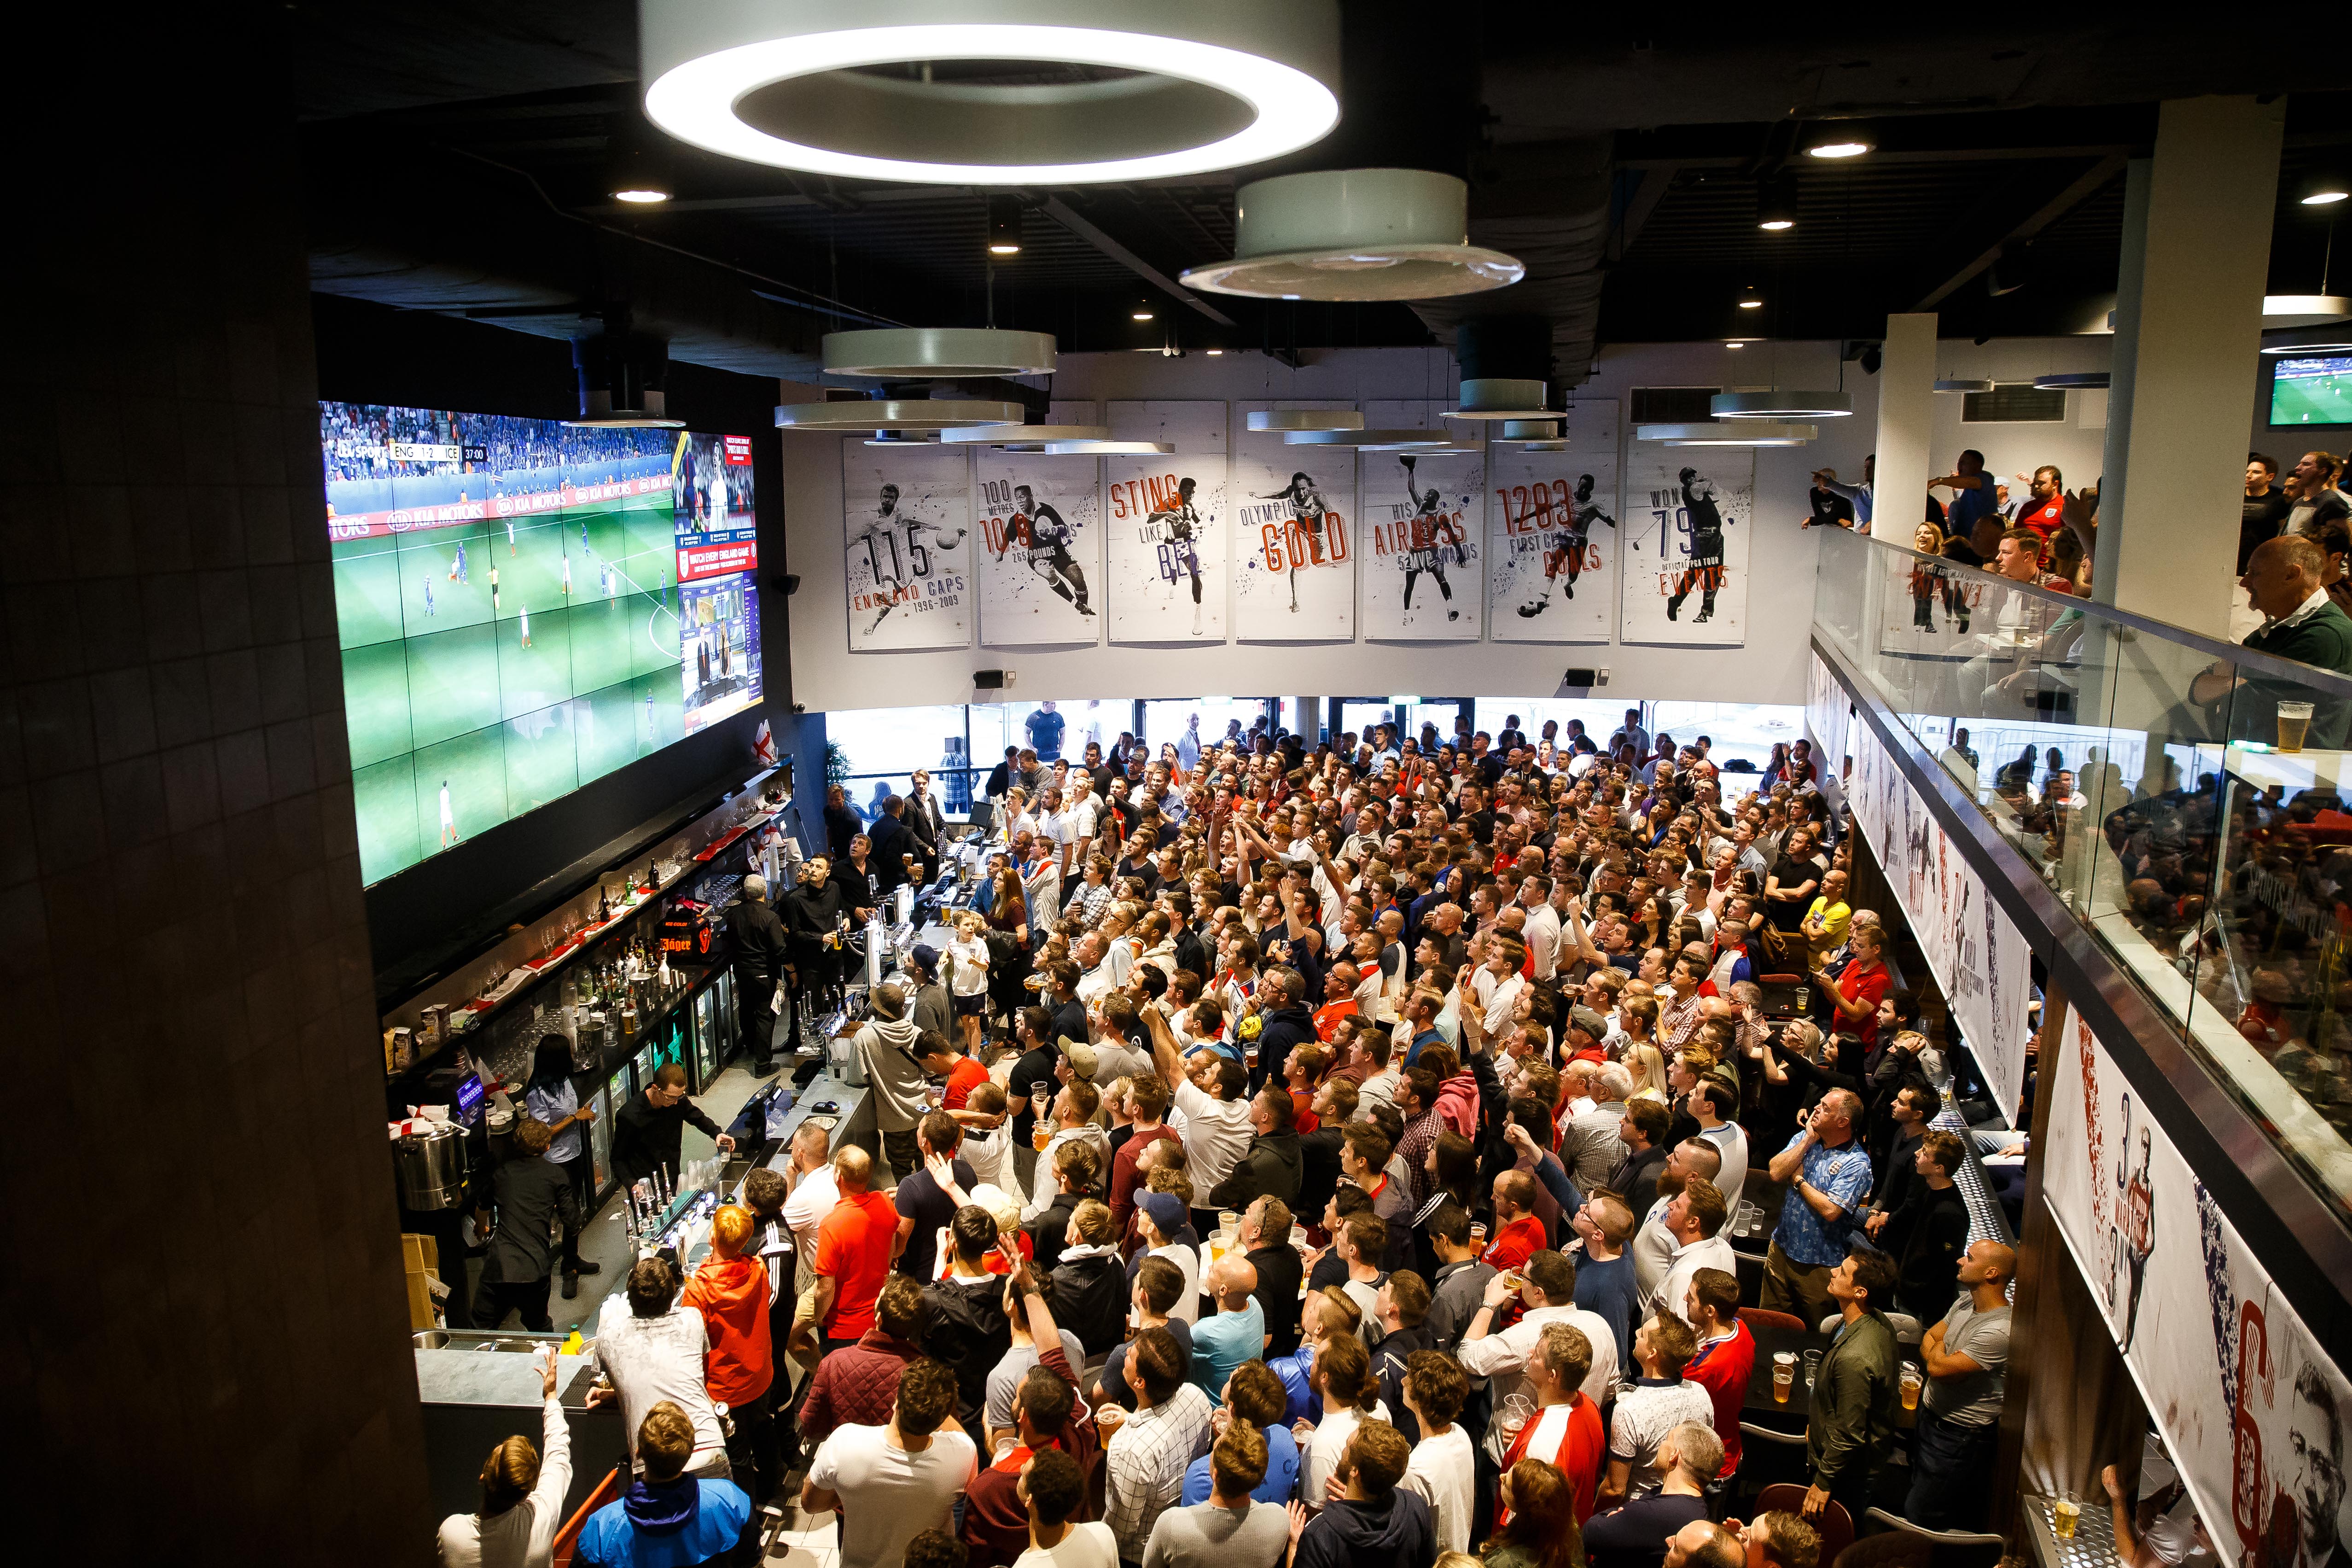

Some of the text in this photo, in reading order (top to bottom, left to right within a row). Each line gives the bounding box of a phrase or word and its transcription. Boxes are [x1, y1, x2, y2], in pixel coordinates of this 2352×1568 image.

[355, 446, 387, 459] SPORT
[395, 446, 457, 459] ENG 1-2 ICE
[465, 449, 483, 460] 37:00
[589, 489, 602, 501] KIA
[603, 483, 631, 498] MOTORS
[650, 478, 661, 489] KIA
[981, 479, 1012, 505] 100
[515, 498, 533, 512] KIA
[533, 492, 567, 511] MOTORS
[1110, 473, 1182, 519] STING
[1650, 488, 1680, 508] WON
[413, 508, 436, 527] KIA
[437, 503, 484, 525] MOTORS
[988, 502, 1014, 516] METRES
[1240, 499, 1296, 526] OLYMPIC
[1391, 502, 1413, 520] HIS
[1496, 479, 1572, 536] 1283
[328, 516, 370, 538] TORS
[1139, 521, 1175, 544] LIKE A
[1652, 507, 1694, 559] 79
[1262, 512, 1347, 572] GOLD
[1509, 535, 1541, 554] FIRST
[705, 551, 719, 562] EVERY
[719, 548, 738, 560] ENGLAND
[738, 547, 750, 558] GAME
[861, 525, 930, 586] 115
[1013, 546, 1056, 563] 265 POUNDS
[1397, 555, 1405, 571] 5
[1409, 550, 1433, 568] MVP
[1662, 556, 1720, 571] OFFICIAL PGA TOUR
[1659, 565, 1728, 597] EVENTS
[854, 576, 964, 612] ENGLAND CAPS
[913, 594, 959, 613] 1996-2009
[662, 938, 691, 952] Jäger
